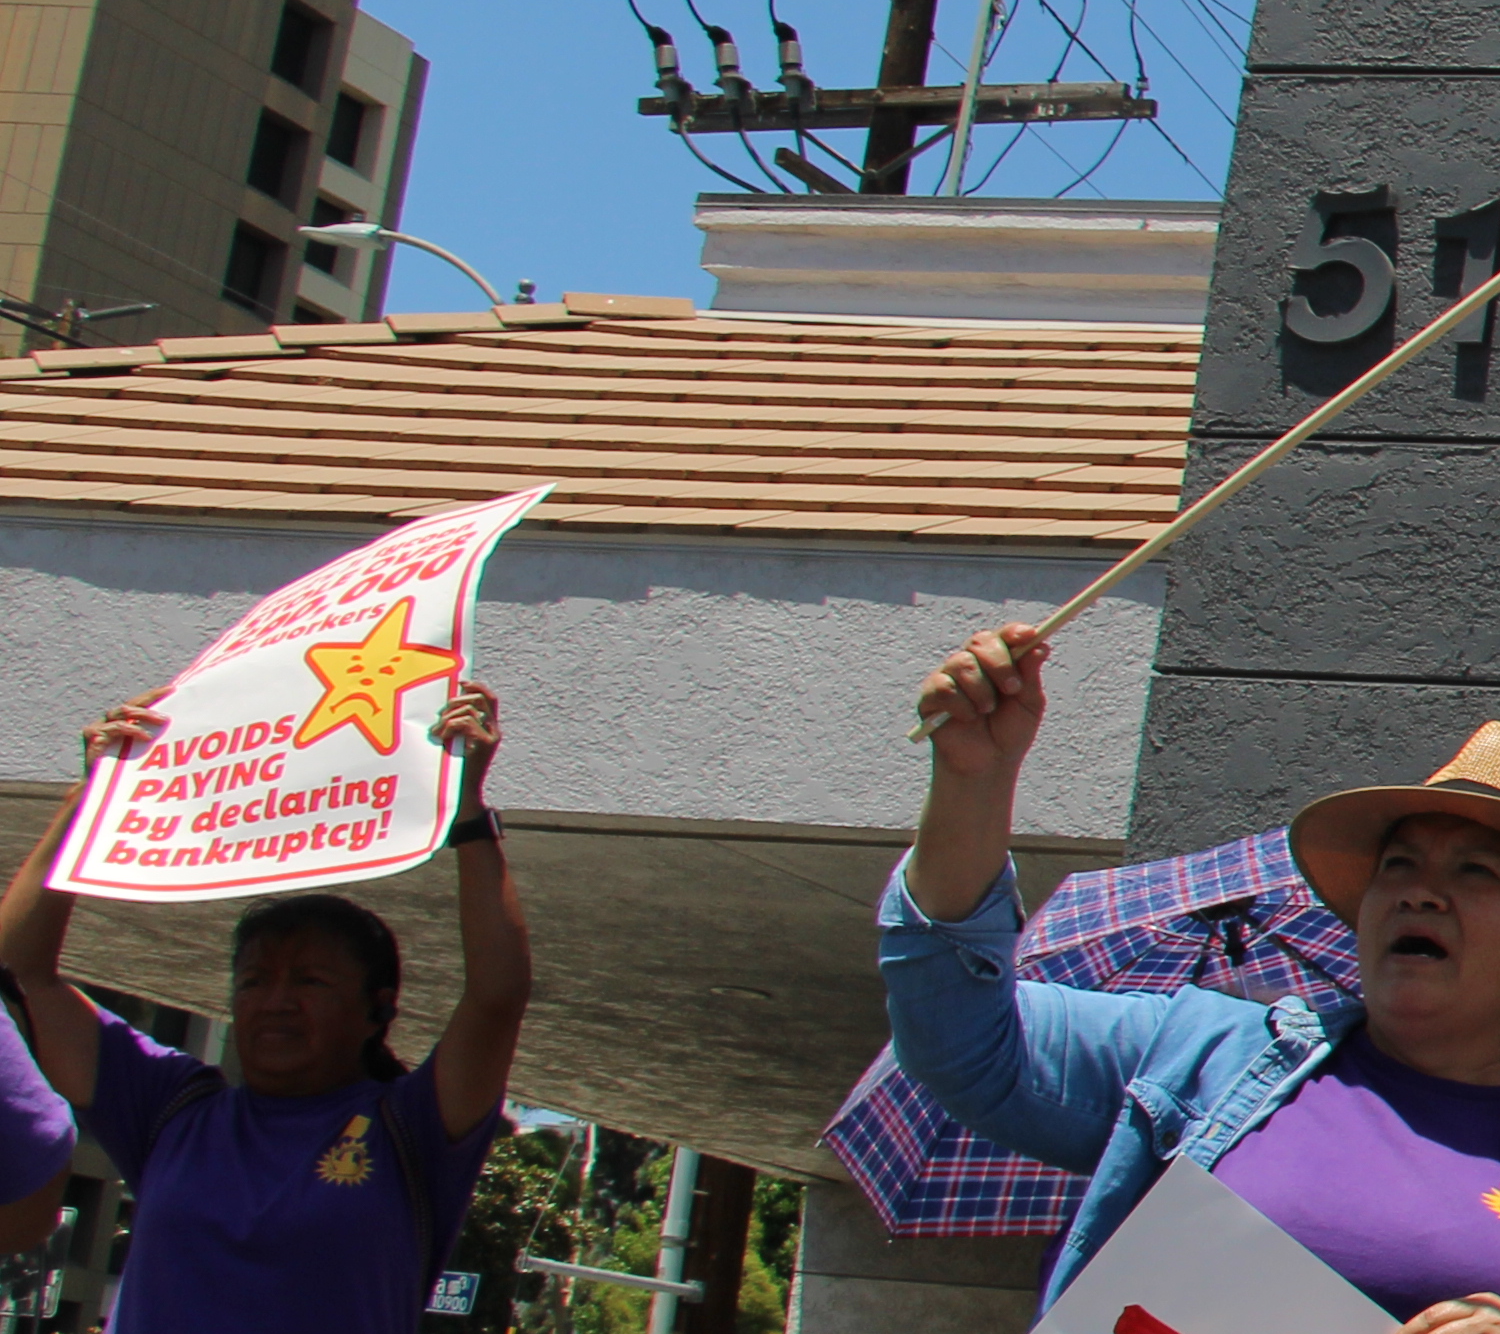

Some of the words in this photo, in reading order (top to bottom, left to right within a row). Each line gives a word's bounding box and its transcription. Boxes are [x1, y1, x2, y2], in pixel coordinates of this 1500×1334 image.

[138, 714, 297, 771] AVOIDS
[129, 752, 286, 802] PAYING
[116, 810, 181, 841] by
[191, 775, 398, 833] declaring
[103, 811, 392, 866] bankruptcy!
